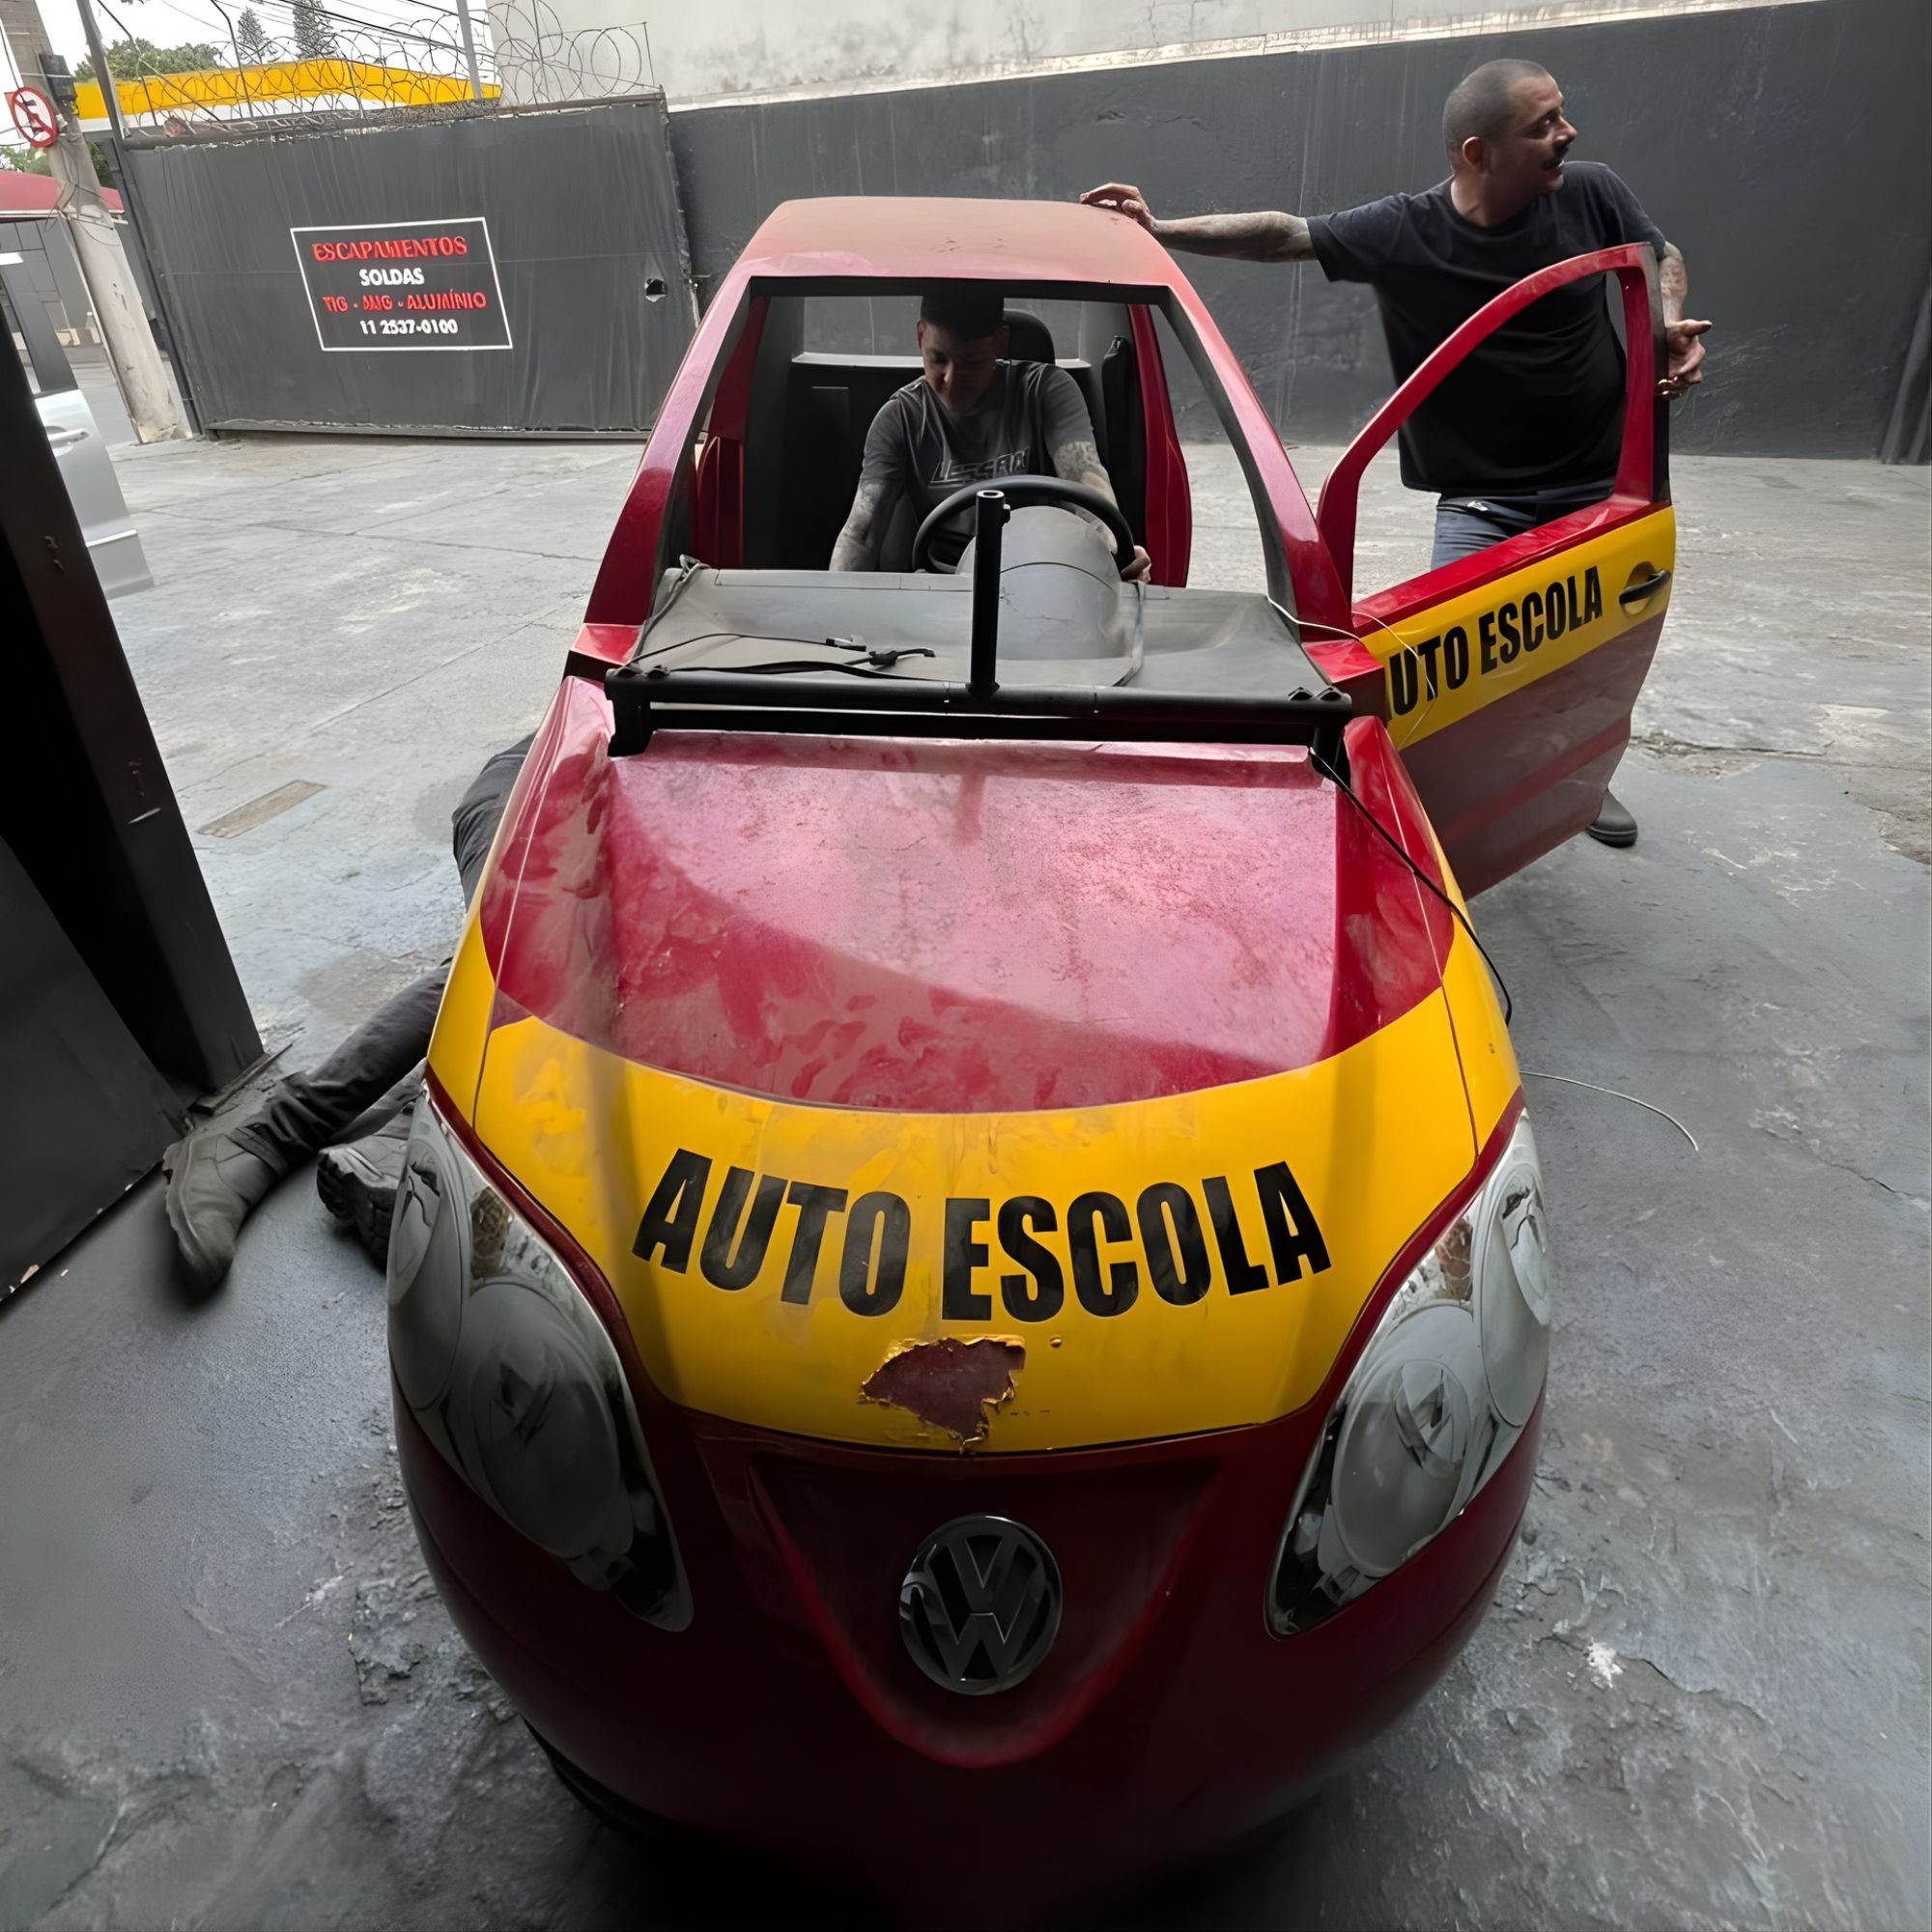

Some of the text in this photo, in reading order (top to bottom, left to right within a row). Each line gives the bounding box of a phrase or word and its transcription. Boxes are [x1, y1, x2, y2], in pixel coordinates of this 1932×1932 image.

[323, 296, 349, 313] TIG
[407, 289, 487, 310] ALUMÍNIO
[359, 268, 425, 287] SOLDAS
[360, 320, 377, 334] 11
[1388, 566, 1603, 716] UTO ESCOLA
[632, 1149, 1332, 1323] AUTO ESCOLA
[904, 1519, 1059, 1690] VW
